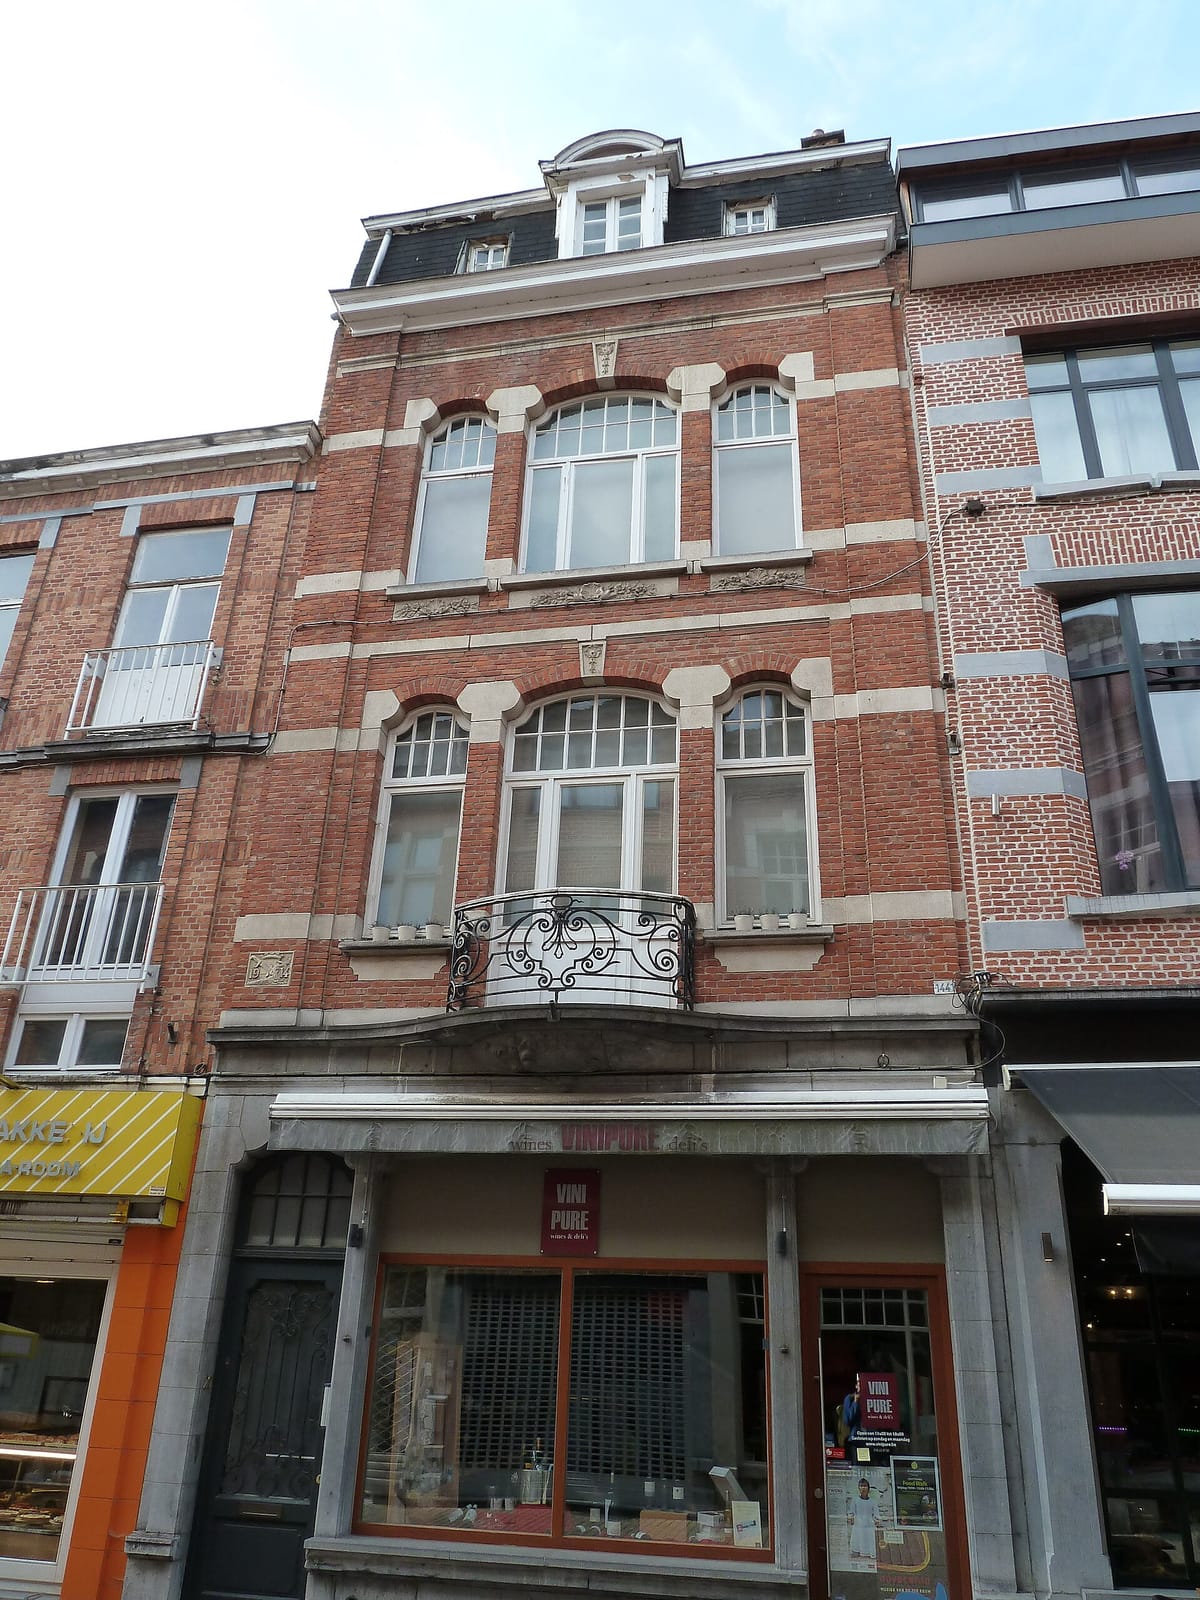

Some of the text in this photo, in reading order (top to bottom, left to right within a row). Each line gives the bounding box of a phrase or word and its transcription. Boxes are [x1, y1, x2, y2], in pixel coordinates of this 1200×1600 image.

[510, 1135, 553, 1151] wines
[556, 1183, 587, 1204] VINI
[550, 1210, 589, 1230] PURE
[867, 1381, 889, 1395] VINI
[866, 1399, 893, 1413] PURE
